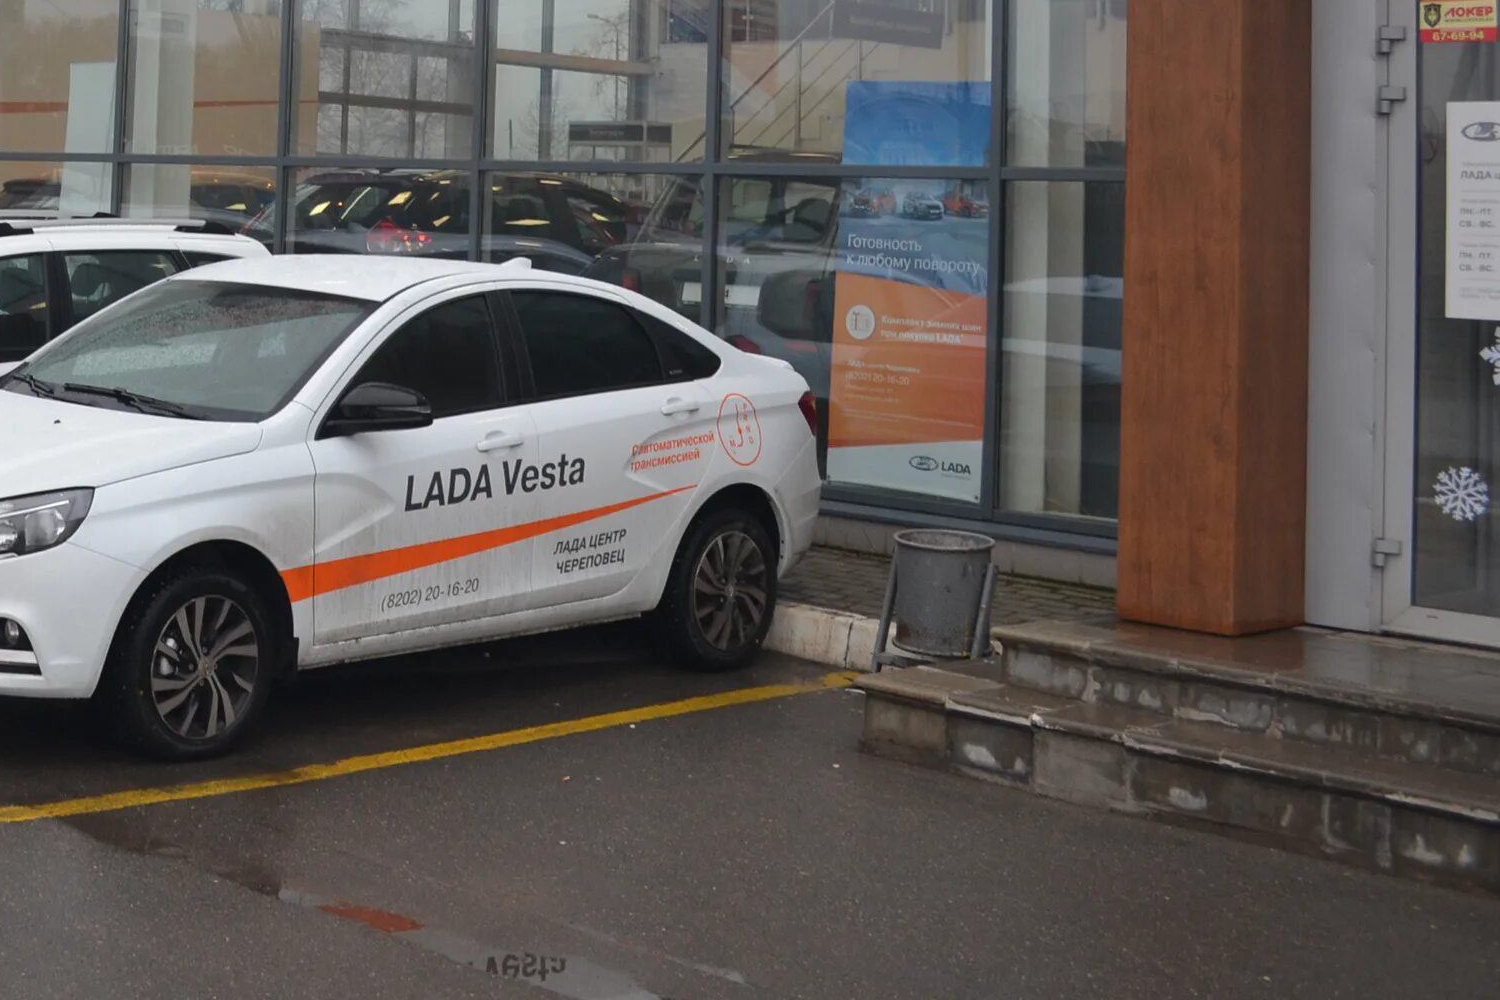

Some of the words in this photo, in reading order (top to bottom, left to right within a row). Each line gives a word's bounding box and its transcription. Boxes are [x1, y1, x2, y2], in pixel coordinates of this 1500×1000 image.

[1444, 6, 1493, 18] ЛОКЕР
[1432, 29, 1485, 41] 67-69-94
[847, 233, 922, 251] Готовность
[846, 254, 855, 266] к
[857, 253, 912, 272] любому
[914, 258, 981, 275] повороту
[630, 448, 700, 473] трансмиссией
[941, 460, 972, 475] LADA
[404, 463, 493, 512] LADA
[502, 453, 586, 496] Vesta
[553, 535, 587, 555] ЛАДА
[588, 528, 627, 549] ЦЕНТР
[556, 548, 626, 575] ЧЕРЕПОВЕЦ
[380, 588, 422, 613] (8202)
[425, 577, 480, 602] 20-16-20
